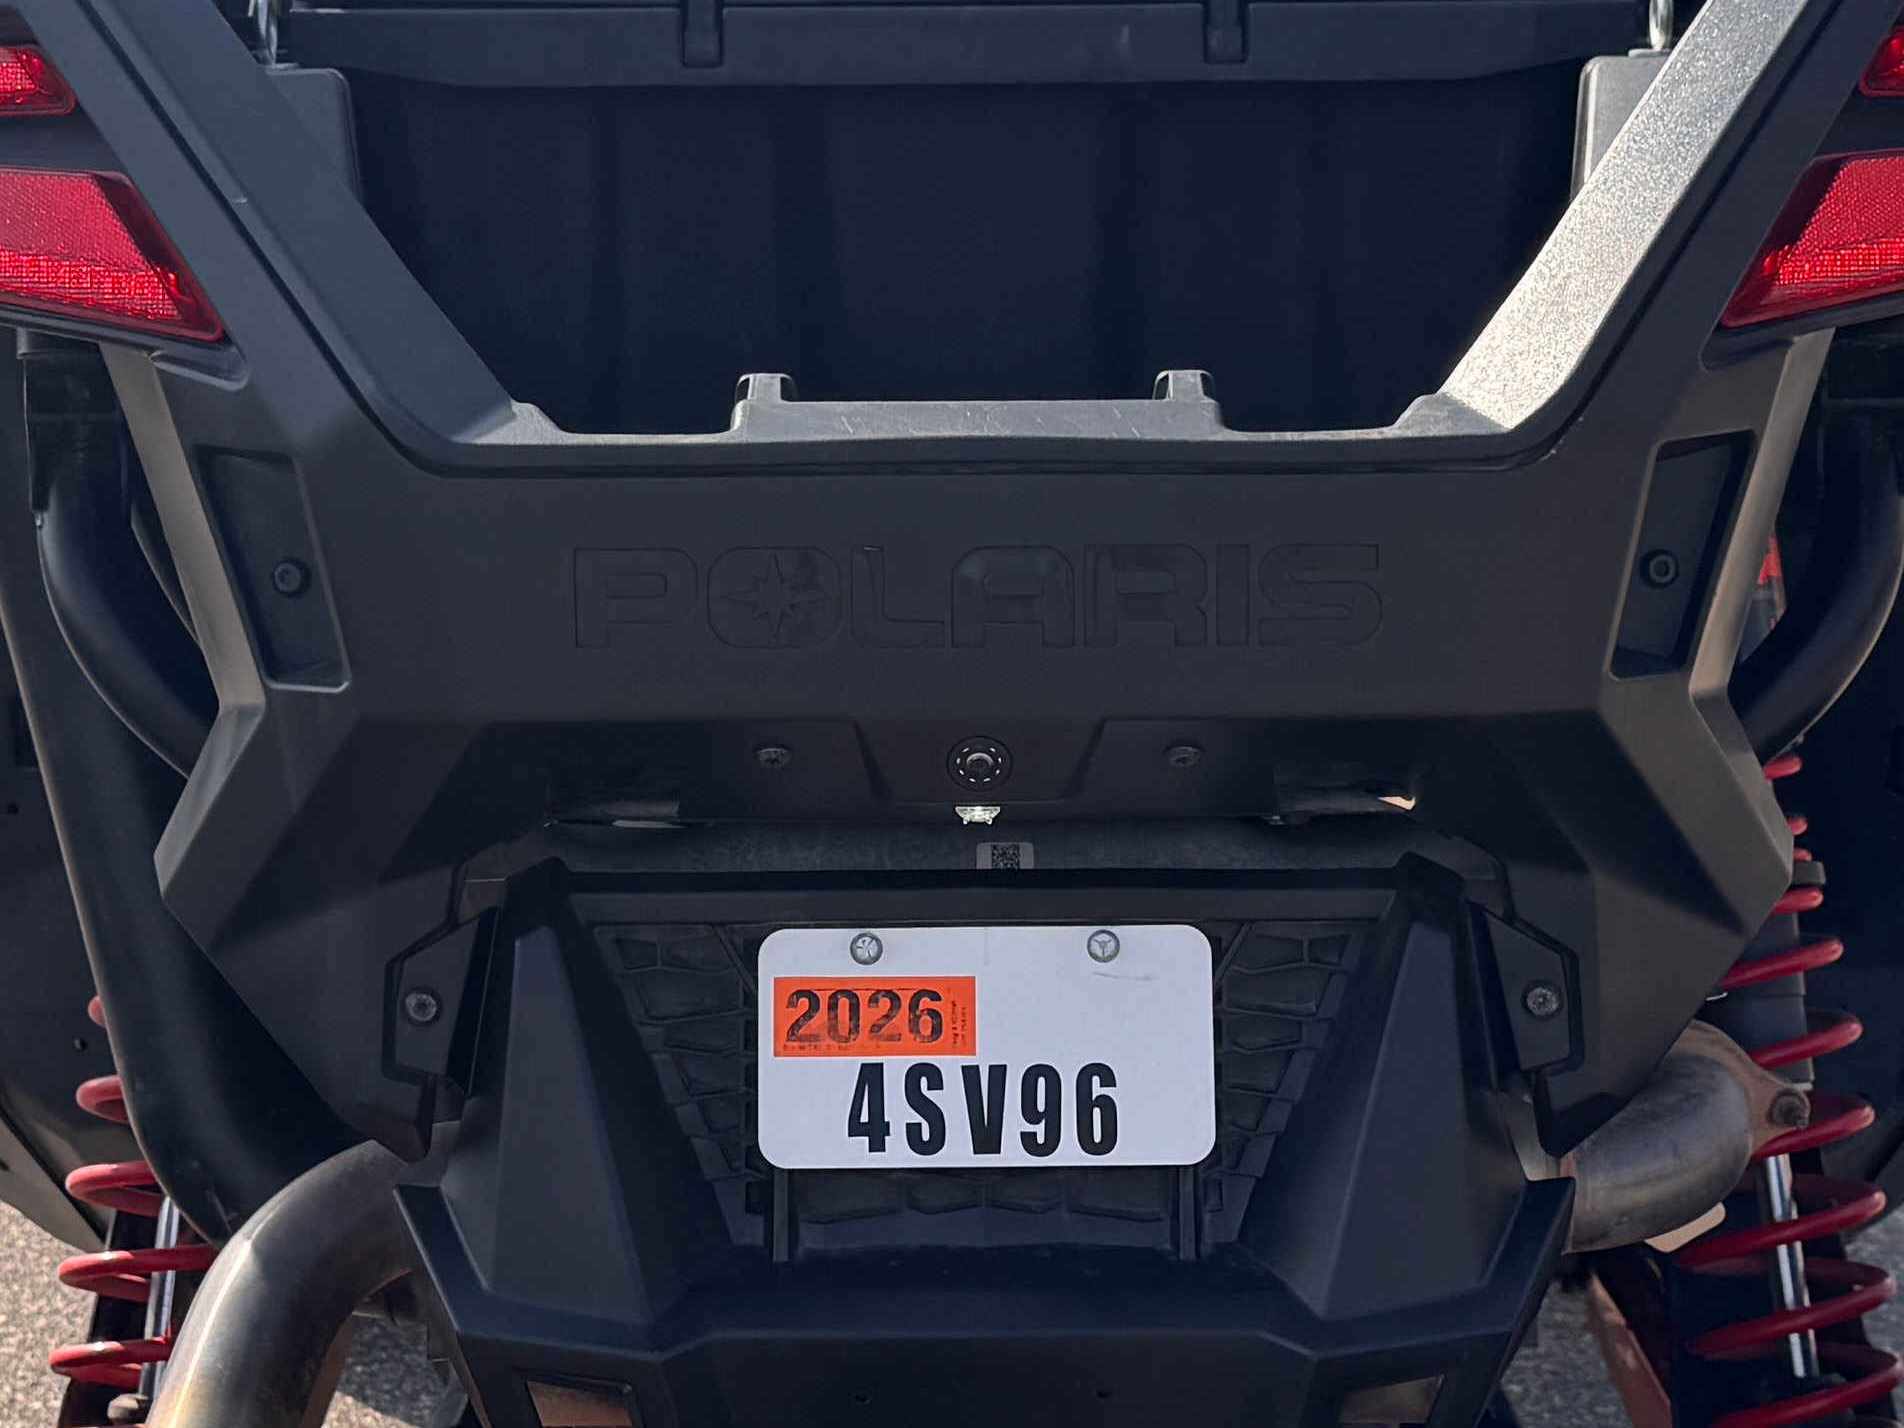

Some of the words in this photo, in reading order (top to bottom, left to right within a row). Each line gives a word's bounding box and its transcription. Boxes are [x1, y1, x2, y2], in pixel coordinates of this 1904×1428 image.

[574, 543, 1383, 648] POLARIS
[786, 988, 944, 1043] 2026
[847, 1062, 1118, 1157] 4SV96
